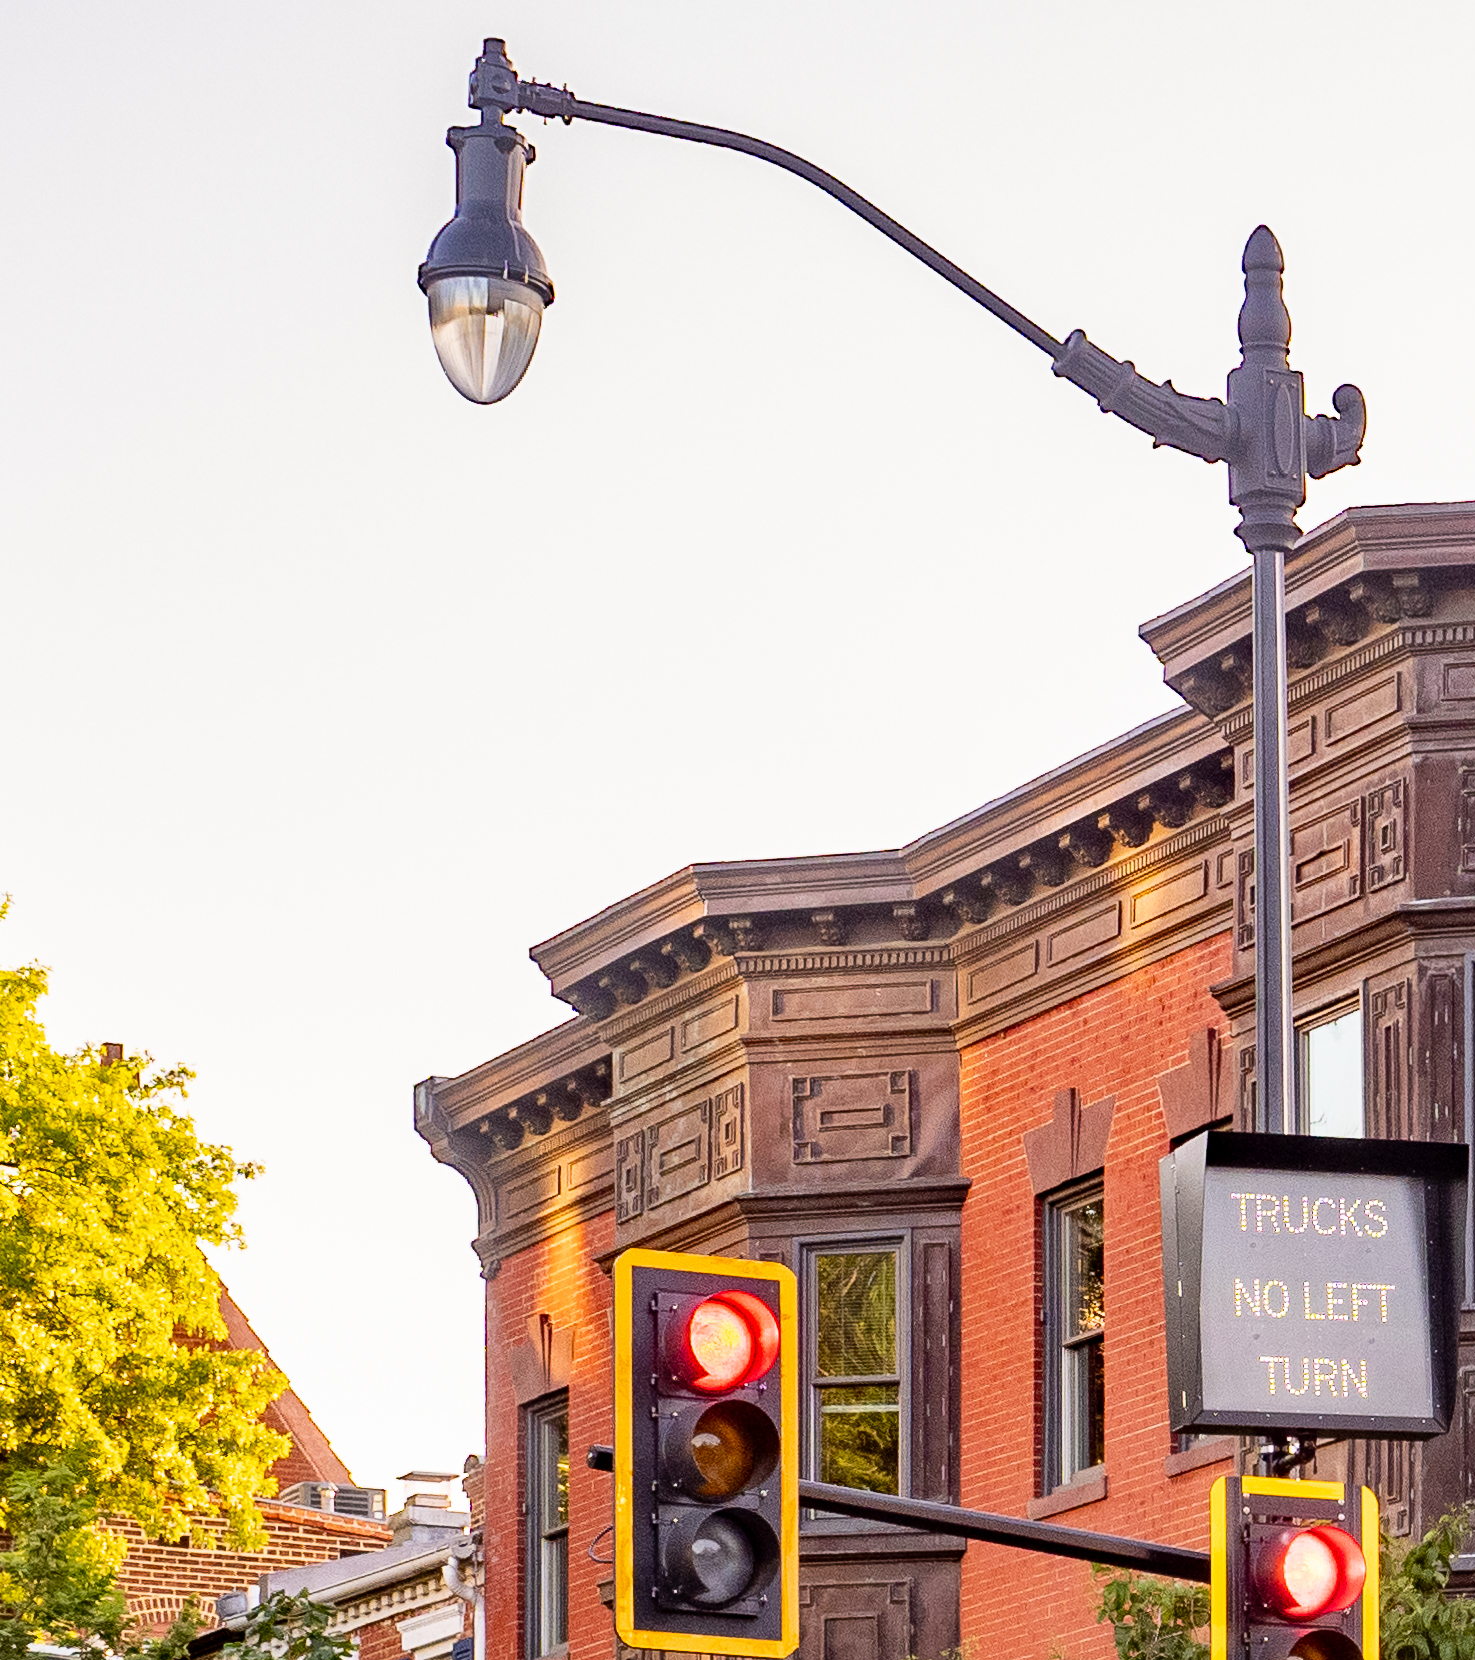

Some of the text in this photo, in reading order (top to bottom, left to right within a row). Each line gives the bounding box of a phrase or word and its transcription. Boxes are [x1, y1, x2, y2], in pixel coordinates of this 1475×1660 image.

[1231, 1192, 1389, 1238] TRUCKS
[1234, 1277, 1396, 1323] NO LEFT
[1259, 1355, 1368, 1398] TURN
